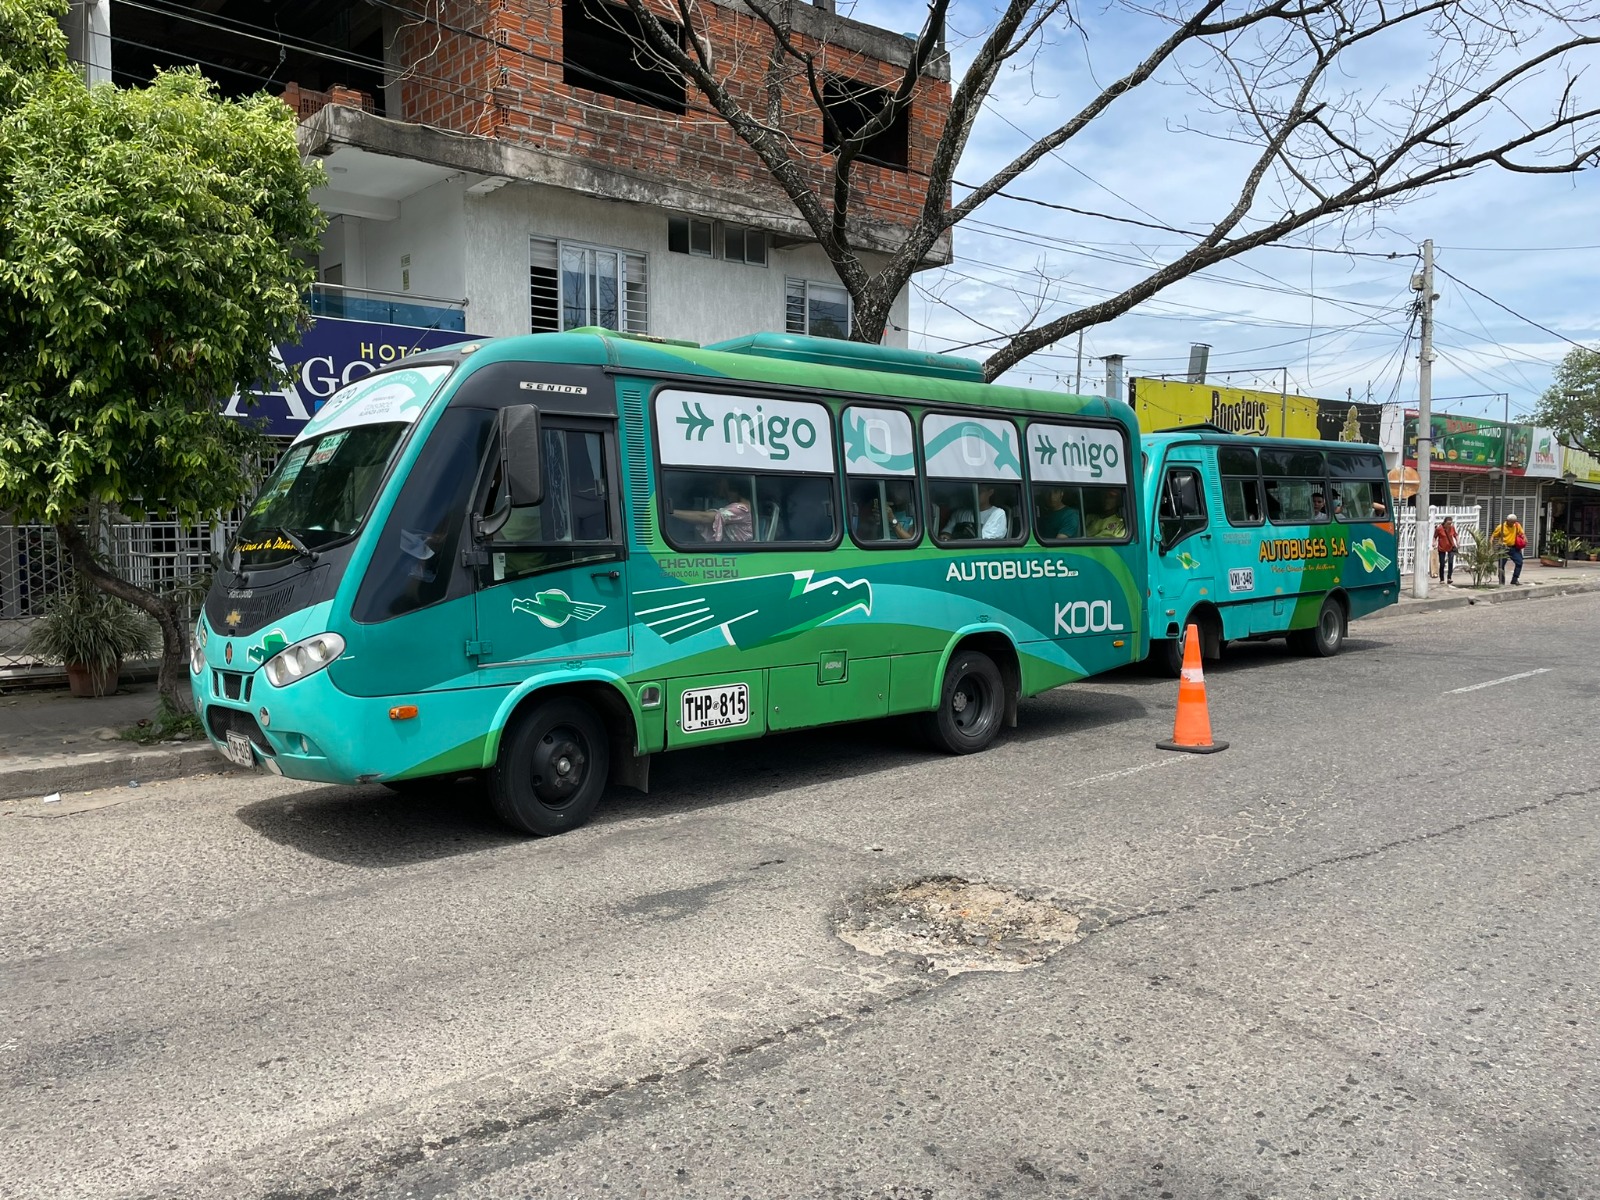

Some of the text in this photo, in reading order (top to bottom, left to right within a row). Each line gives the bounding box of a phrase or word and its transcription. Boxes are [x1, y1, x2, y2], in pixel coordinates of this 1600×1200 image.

[526, 382, 583, 394] SENIOR
[1211, 390, 1266, 432] Roosters
[723, 405, 817, 460] migo
[1478, 424, 1502, 438] ANDINO
[1062, 435, 1119, 478] migo
[1259, 538, 1328, 562] AUTOBUSES
[658, 557, 737, 569] CHEVROLET
[702, 569, 739, 580] ISUZU
[946, 559, 1068, 582] AUTOBUSES
[1054, 600, 1124, 636] KOOL
[700, 717, 732, 728] NEIVA
